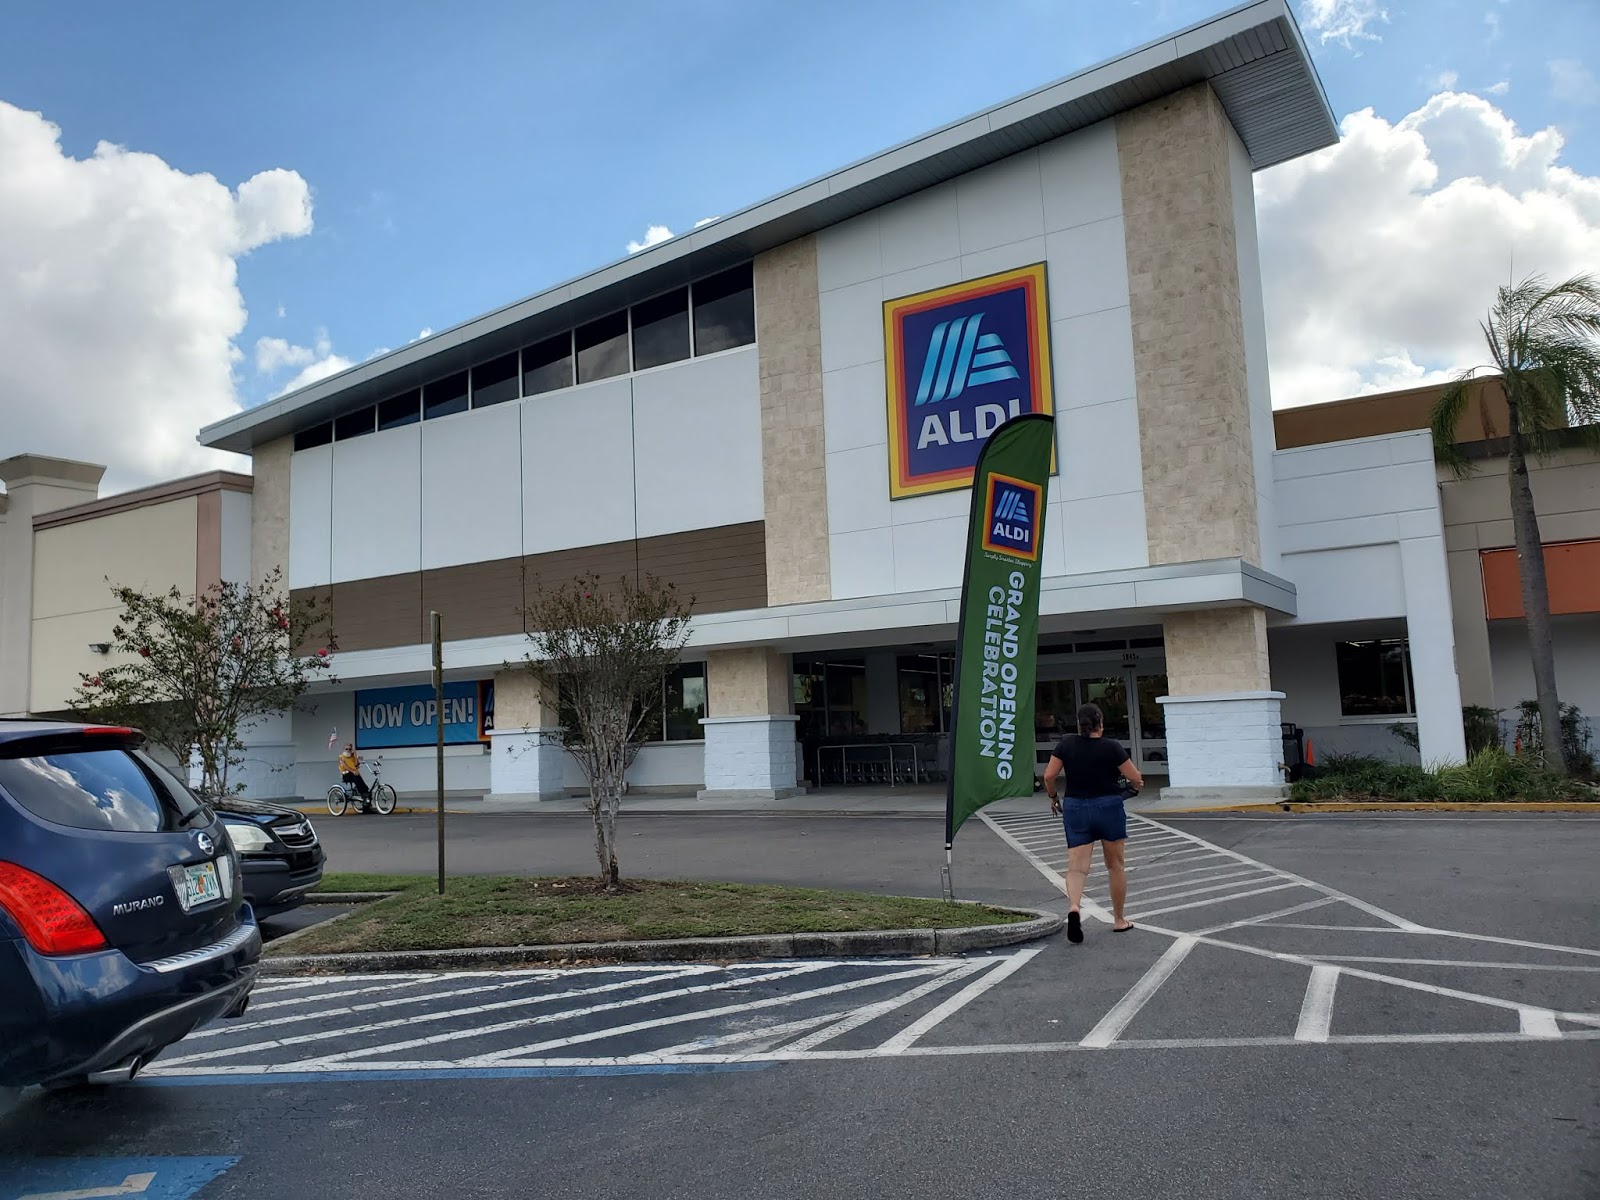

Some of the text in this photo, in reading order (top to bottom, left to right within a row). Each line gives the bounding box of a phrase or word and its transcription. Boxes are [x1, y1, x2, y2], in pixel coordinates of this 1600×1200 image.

[993, 522, 1029, 543] ALDI
[979, 585, 1005, 758] CELEBRATION
[997, 571, 1025, 780] GRAND OPENING
[358, 702, 405, 729] NOW
[410, 697, 474, 727] OPEN!
[113, 895, 164, 916] MURANO
